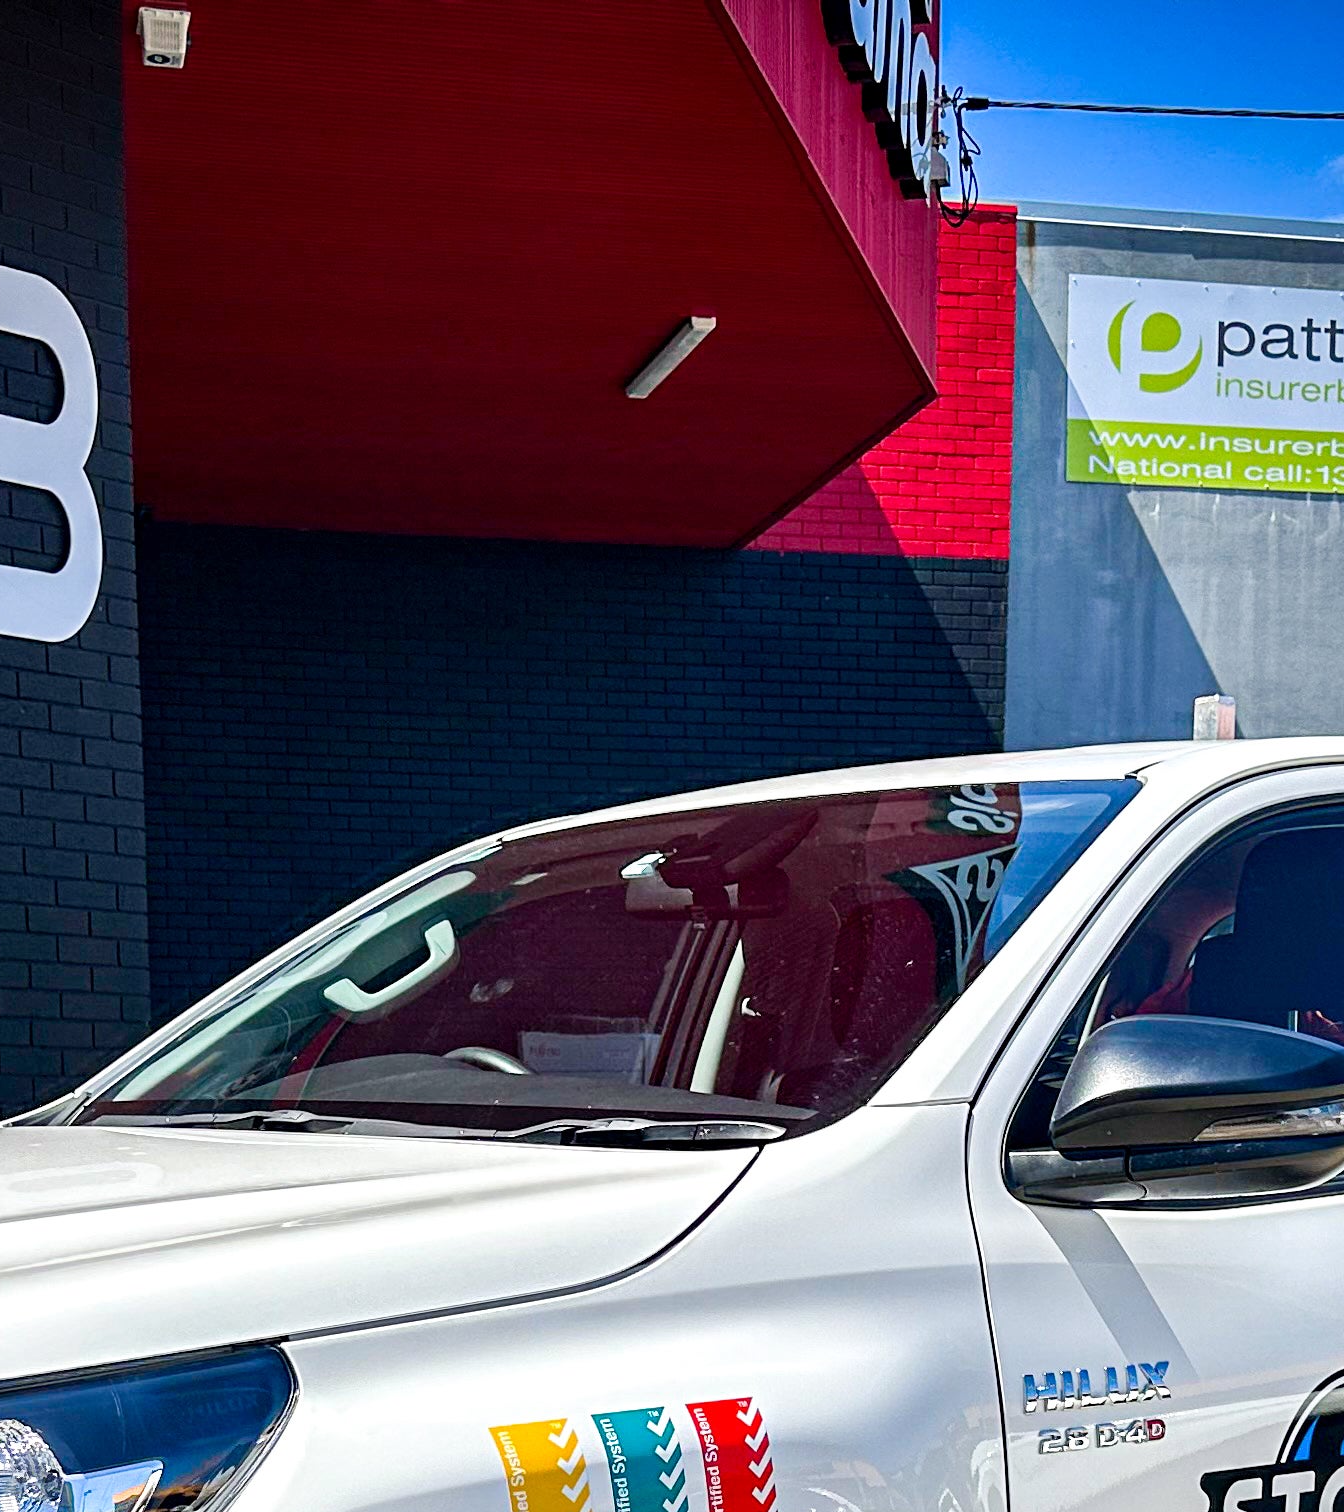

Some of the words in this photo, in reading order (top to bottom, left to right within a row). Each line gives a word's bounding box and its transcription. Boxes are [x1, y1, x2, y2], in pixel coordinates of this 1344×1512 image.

[1089, 456, 1233, 480] National
[1022, 1360, 1172, 1416] HILUX
[497, 1430, 525, 1487] System
[600, 1418, 626, 1476] System
[692, 1407, 718, 1462] System
[1096, 1418, 1167, 1448] D-4D
